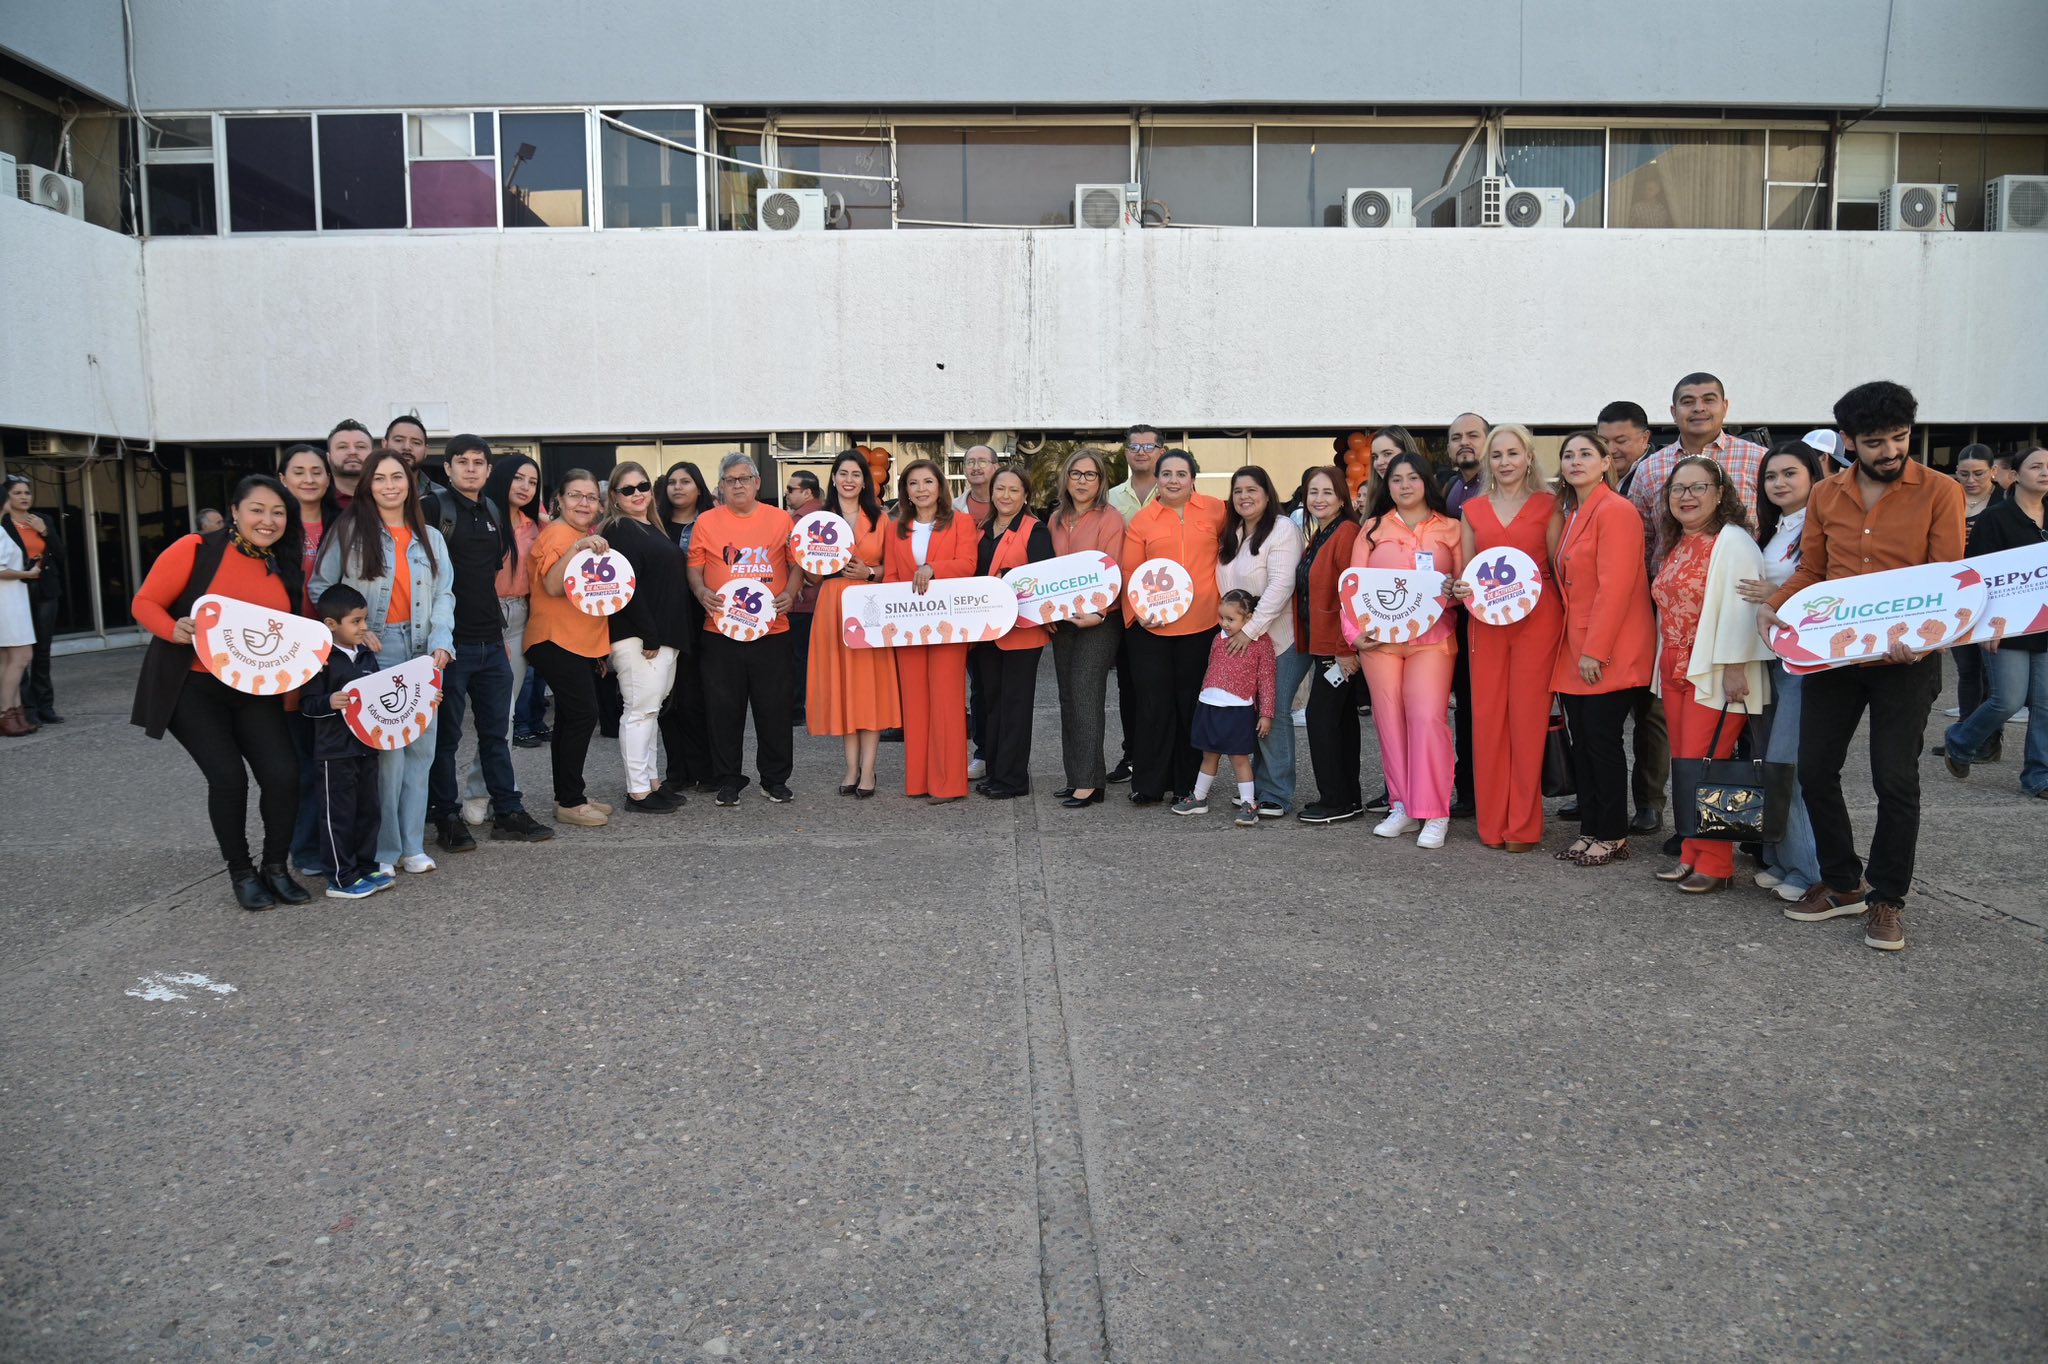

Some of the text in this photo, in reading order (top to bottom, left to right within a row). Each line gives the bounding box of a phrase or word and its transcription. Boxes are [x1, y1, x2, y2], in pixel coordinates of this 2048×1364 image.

[807, 520, 839, 545] 16
[581, 556, 616, 584] 16
[731, 564, 773, 573] FETASA
[1141, 566, 1174, 595] 16
[1476, 555, 1516, 592] 16
[1983, 566, 2048, 588] SEPyC
[1035, 572, 1099, 596] UIGCEDH
[732, 586, 764, 614] 16
[885, 600, 947, 614] SINALOA
[953, 594, 989, 606] SEPyC
[1362, 592, 1423, 622] Educamos para la paz
[1835, 592, 1943, 621] UIGCEDH
[223, 628, 301, 670] Educamos para la paz
[367, 703, 400, 725] Educamos
[400, 707, 415, 724] para
[411, 698, 418, 707] la
